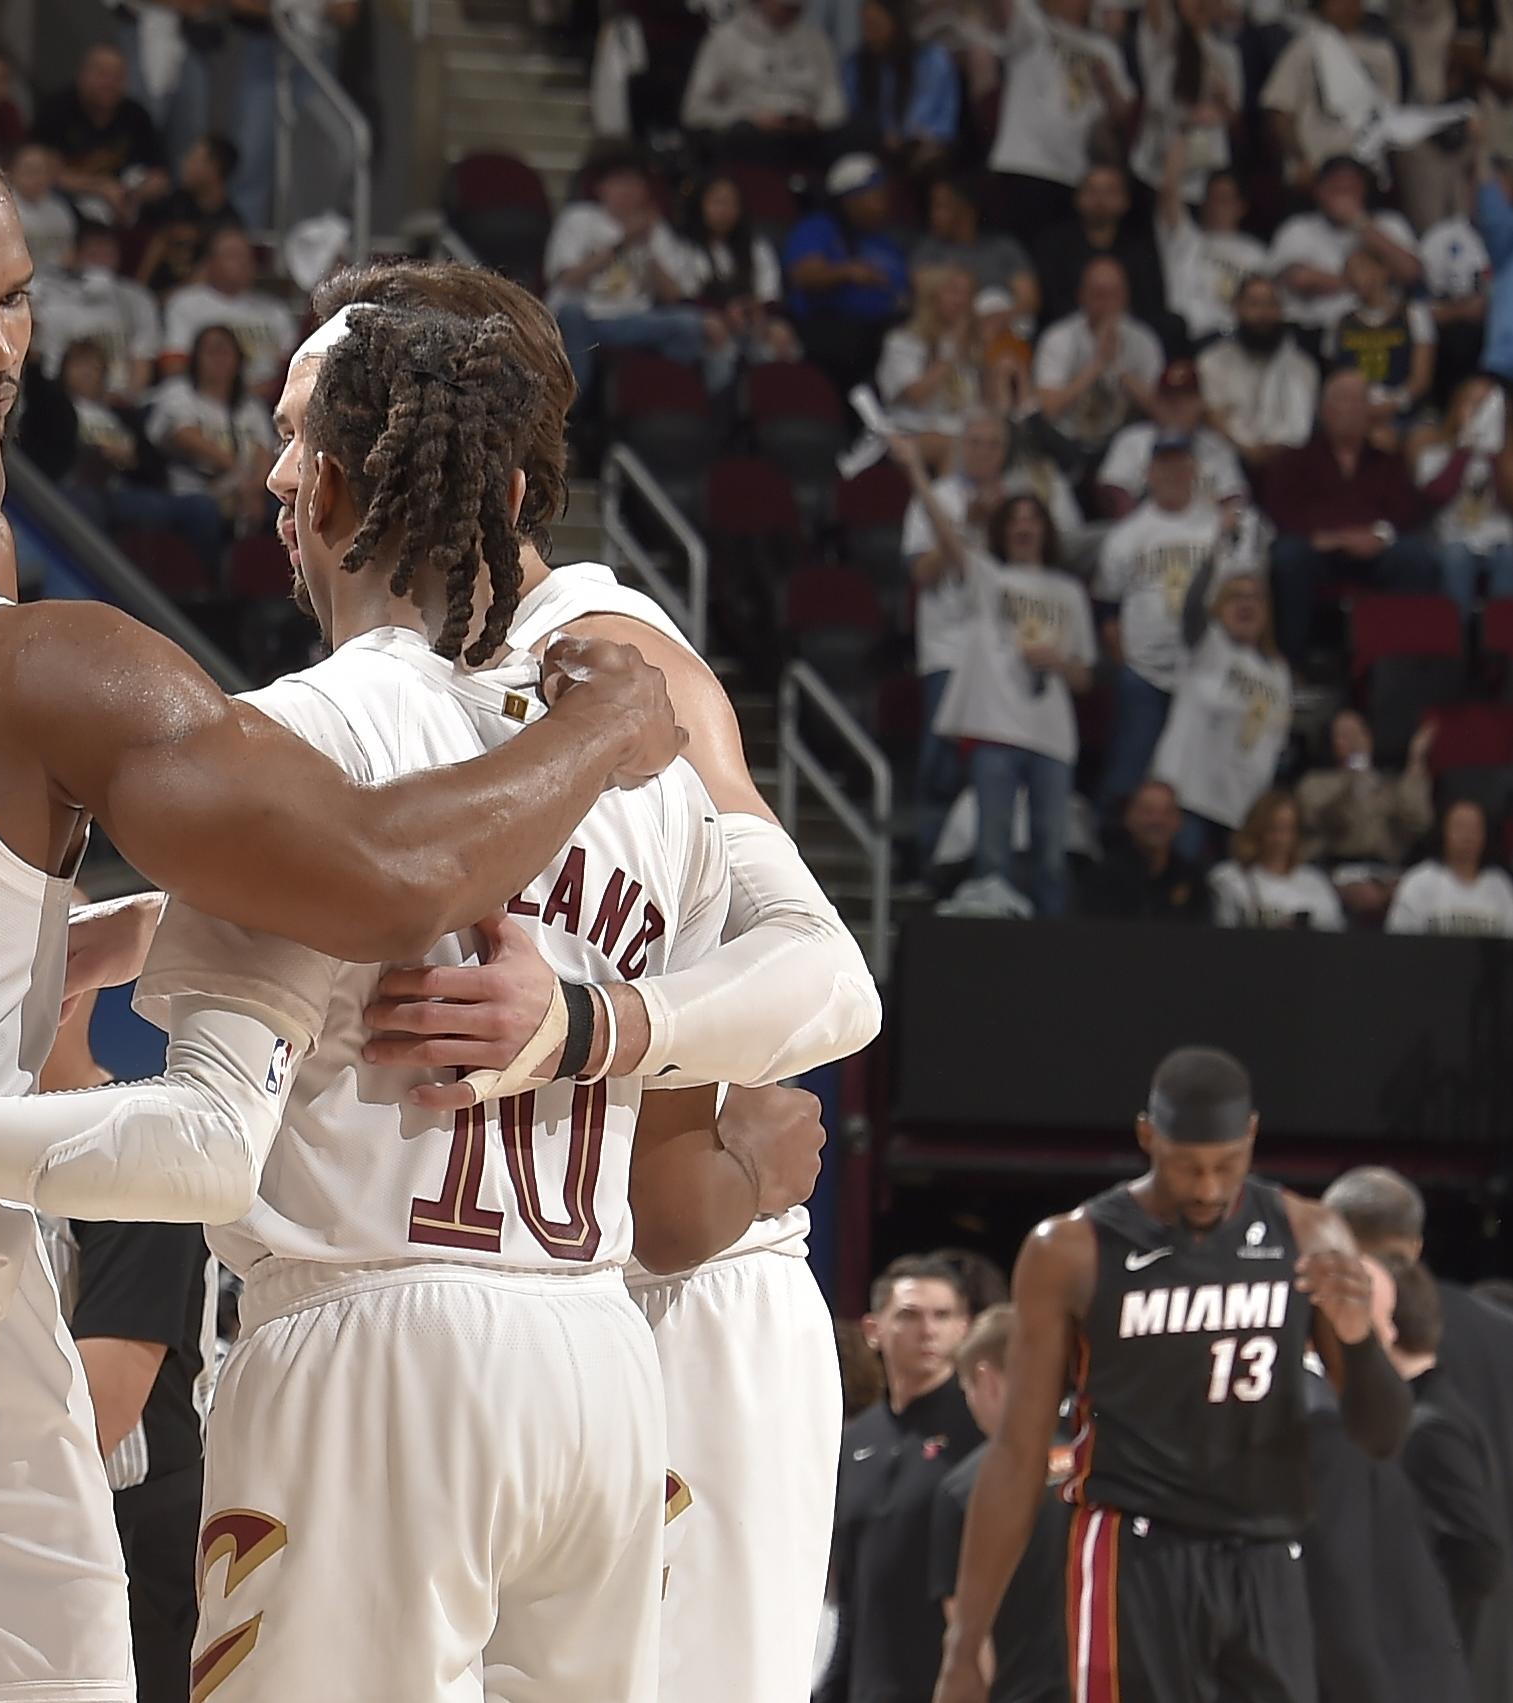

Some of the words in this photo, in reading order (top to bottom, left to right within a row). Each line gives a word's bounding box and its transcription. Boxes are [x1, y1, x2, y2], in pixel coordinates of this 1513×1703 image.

[408, 1068, 606, 1262] 10
[1119, 1281, 1289, 1338] MIAMI
[1208, 1336, 1278, 1403] 13
